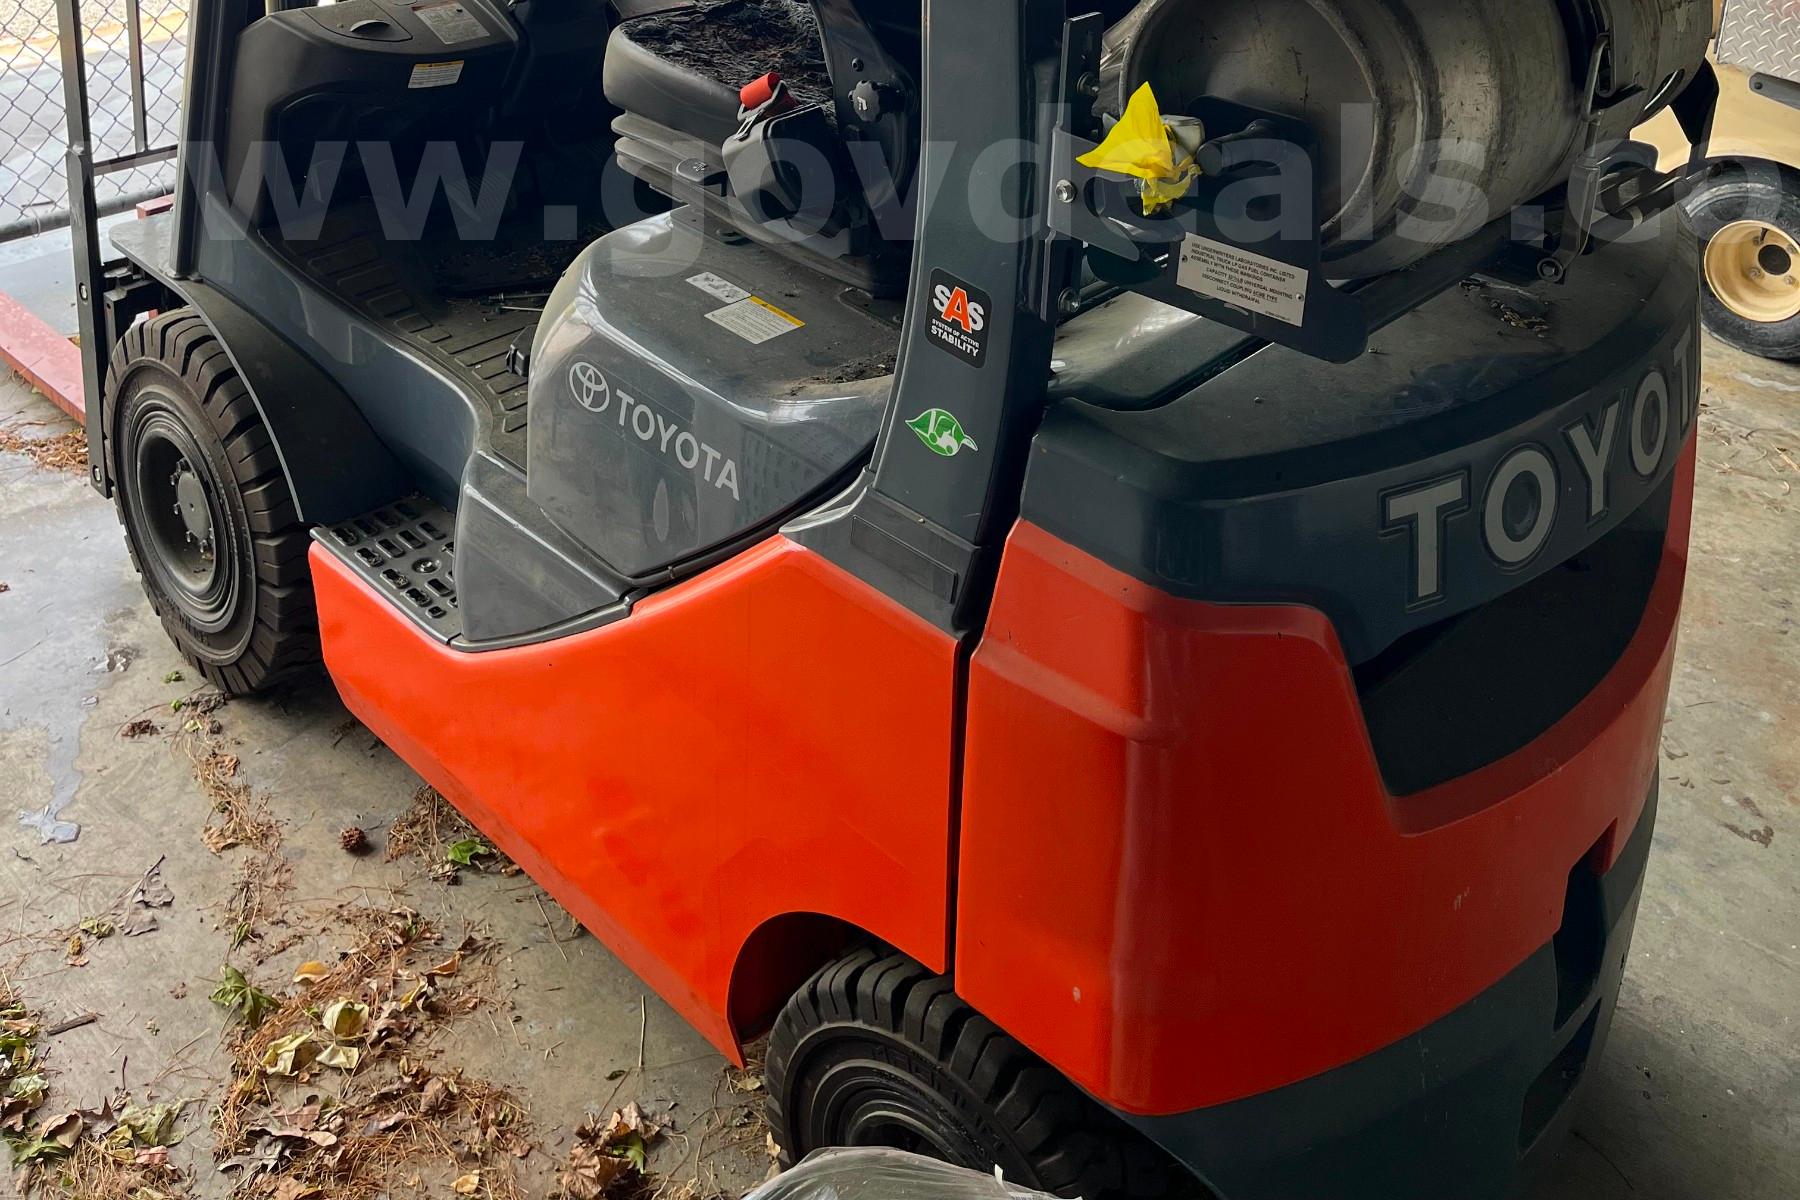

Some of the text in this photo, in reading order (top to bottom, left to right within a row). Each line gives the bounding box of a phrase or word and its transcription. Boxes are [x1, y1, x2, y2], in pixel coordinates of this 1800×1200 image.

[933, 284, 984, 334] SAS
[931, 325, 979, 357] STABILITY
[960, 334, 980, 349] ACTIVE
[616, 389, 740, 501] TOYOTA
[1388, 323, 1692, 598] TOYOT
